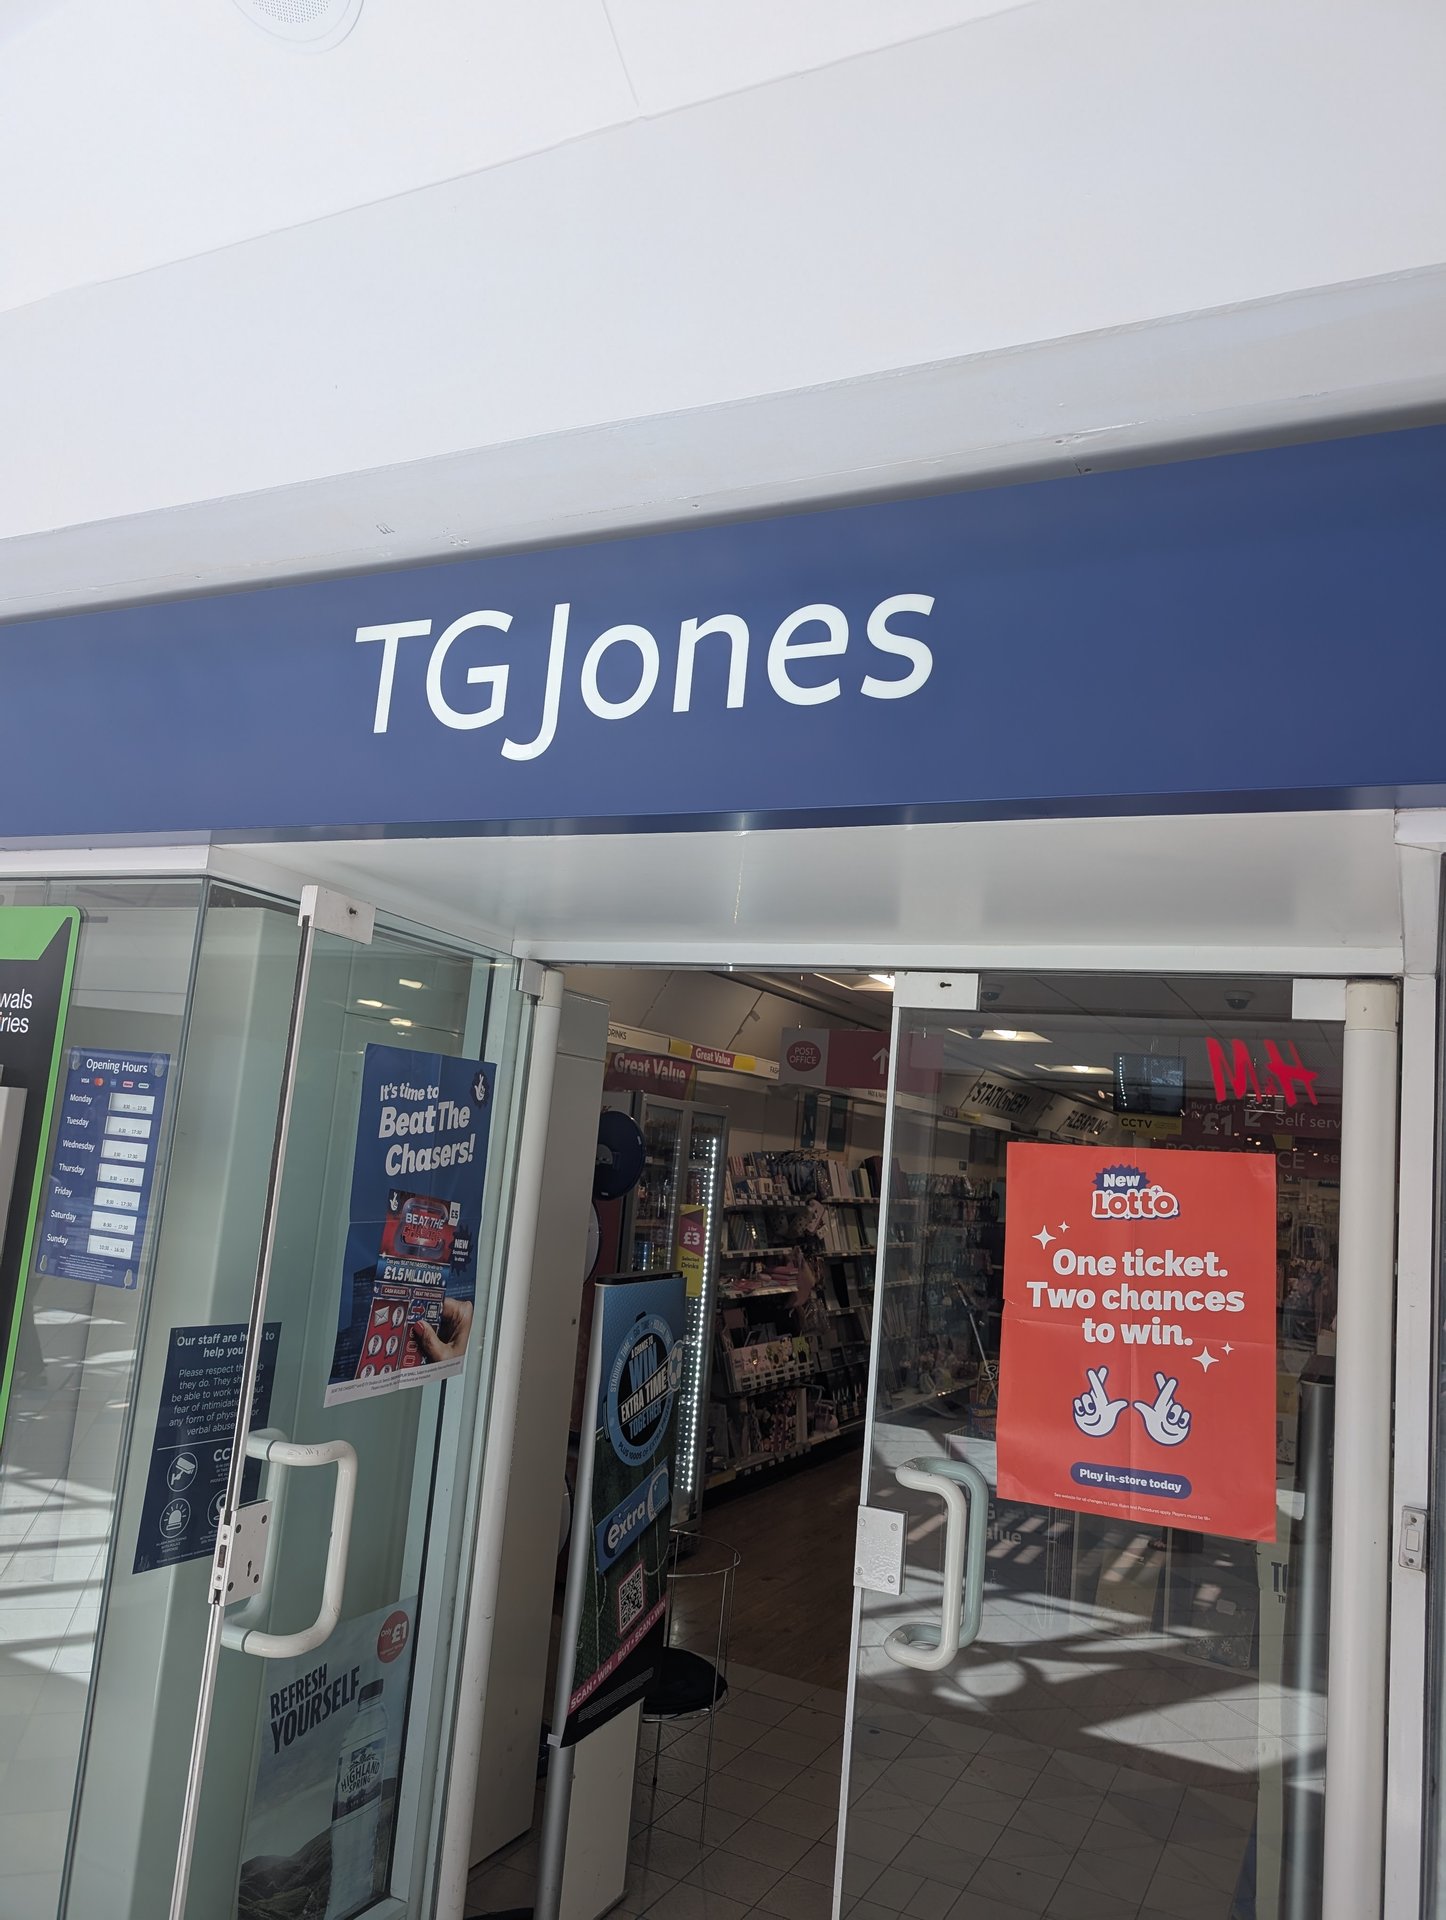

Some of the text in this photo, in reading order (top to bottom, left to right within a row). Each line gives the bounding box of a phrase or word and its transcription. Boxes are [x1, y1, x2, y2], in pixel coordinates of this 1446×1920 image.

[695, 1048, 731, 1066] Great Value
[794, 1047, 815, 1056] POST
[86, 1058, 148, 1074] Opening Hours
[614, 1052, 686, 1081] Great Value
[789, 1055, 817, 1065] OFFICE
[69, 1093, 93, 1105] Monday
[380, 1082, 439, 1101] It's time to
[66, 1116, 89, 1128] Tuesday
[378, 1101, 471, 1138] Beat The
[1121, 1118, 1153, 1129] CCTV
[1202, 1112, 1233, 1136] £1
[1275, 1112, 1306, 1127] Self
[62, 1139, 95, 1152] Wednesday
[385, 1133, 476, 1177] Chasers!
[58, 1163, 85, 1176] Thursday
[1103, 1172, 1140, 1188] New
[54, 1186, 73, 1198] Friday
[1091, 1189, 1180, 1220] Lotto
[50, 1209, 77, 1223] Saturday
[405, 1212, 445, 1230] BEAT THE
[451, 1209, 459, 1219] £5
[46, 1233, 69, 1246] Sunday
[454, 1238, 469, 1249] NEW
[683, 1232, 700, 1245] £3
[681, 1262, 699, 1270] Drinks
[1052, 1248, 1228, 1278] One ticket.
[383, 1266, 442, 1285] £1.5 MILLION?
[1026, 1281, 1245, 1313] Two chances
[176, 1336, 196, 1347] Our
[197, 1333, 221, 1345] staff
[222, 1333, 237, 1343] are
[265, 1331, 275, 1341] to
[1081, 1316, 1193, 1346] to win.
[203, 1346, 244, 1358] help you
[178, 1365, 234, 1378] Please respect
[628, 1341, 658, 1393] WIN
[179, 1380, 197, 1390] they
[213, 1376, 231, 1386] They
[610, 1358, 623, 1393] STADIUM
[171, 1393, 182, 1402] be
[183, 1391, 201, 1401] able
[202, 1391, 211, 1399] to
[213, 1387, 232, 1398] work
[620, 1390, 645, 1423] EXTRA
[645, 1366, 668, 1402] TIME
[173, 1404, 189, 1414] fear
[191, 1402, 200, 1412] of
[168, 1417, 184, 1427] any
[185, 1414, 205, 1424] form
[206, 1412, 215, 1421] of
[628, 1401, 662, 1440] TOGETHER
[186, 1425, 211, 1436] verbal
[1079, 1467, 1182, 1494] Play in-store today
[607, 1501, 646, 1549] extra
[391, 1620, 408, 1644] £1
[570, 1602, 666, 1709] SCAN WIN BUY SCAN WIN
[269, 1663, 328, 1720] REFRESH
[270, 1665, 360, 1755] YOURSELF
[340, 1760, 381, 1792] HIGHLAND
[348, 1775, 372, 1794] SPRING
